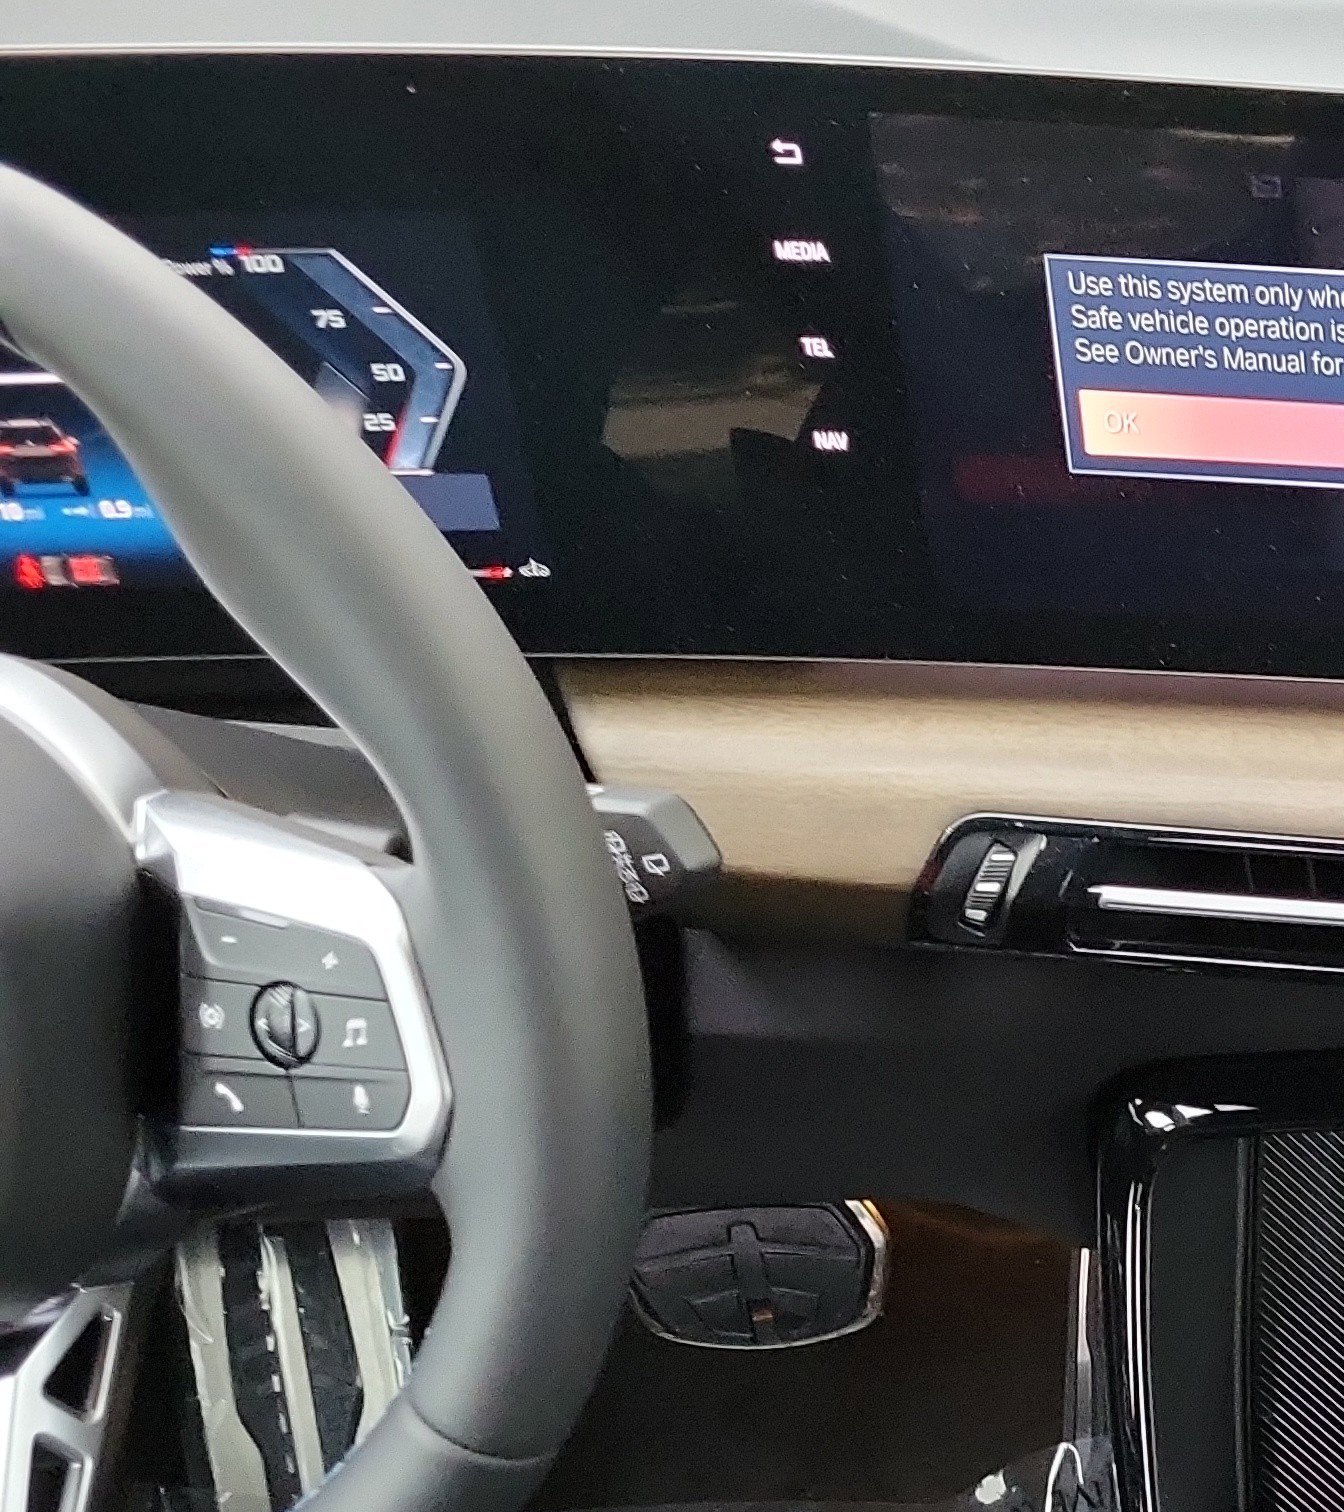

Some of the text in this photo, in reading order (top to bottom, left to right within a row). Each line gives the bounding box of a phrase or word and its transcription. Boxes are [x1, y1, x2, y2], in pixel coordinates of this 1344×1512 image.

[771, 239, 832, 263] MEDIA
[239, 254, 286, 274] 100
[1067, 270, 1114, 297] Use
[1118, 273, 1162, 300] this
[1167, 278, 1249, 306] system
[1254, 282, 1303, 312] only
[310, 308, 347, 329] 75
[1070, 304, 1123, 331] Safe
[1127, 308, 1209, 336] vehicle
[1215, 315, 1324, 343] operation
[799, 335, 836, 359] TEL
[1073, 337, 1120, 363] See
[1125, 340, 1218, 369] Owner's
[1222, 346, 1307, 375] Manual
[1311, 350, 1344, 377] for
[370, 361, 406, 382] 50
[363, 411, 398, 432] 25
[1102, 408, 1141, 435] OK
[811, 429, 850, 452] NAV
